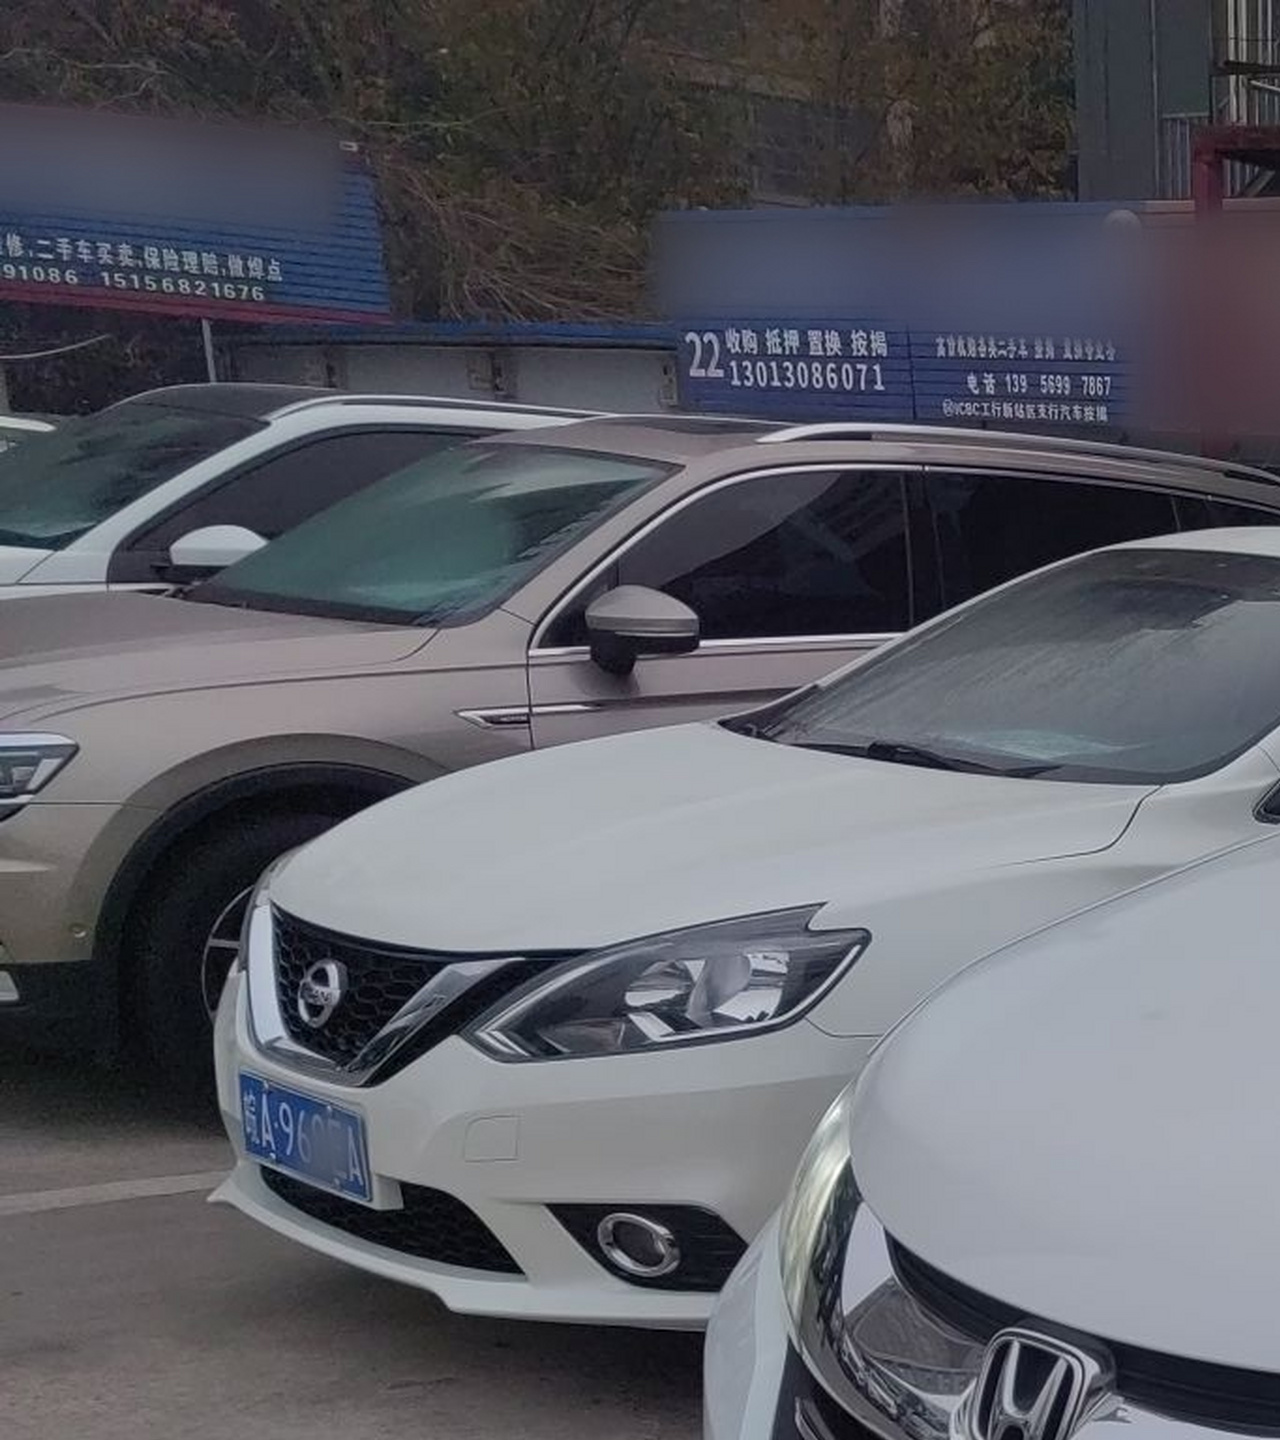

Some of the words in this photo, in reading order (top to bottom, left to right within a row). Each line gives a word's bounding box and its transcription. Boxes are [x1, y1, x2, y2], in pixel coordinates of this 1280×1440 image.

[3, 263, 78, 285] 91086
[101, 271, 265, 301] 15156821676
[685, 331, 724, 377] 22
[725, 328, 758, 354] 收购
[765, 329, 800, 355] 抵押
[808, 330, 842, 356] 置换
[851, 330, 888, 357] 按揭
[729, 360, 886, 391] 13013086071
[966, 372, 996, 395] 电话
[1005, 374, 1028, 393] 139
[1081, 376, 1111, 396] 7867
